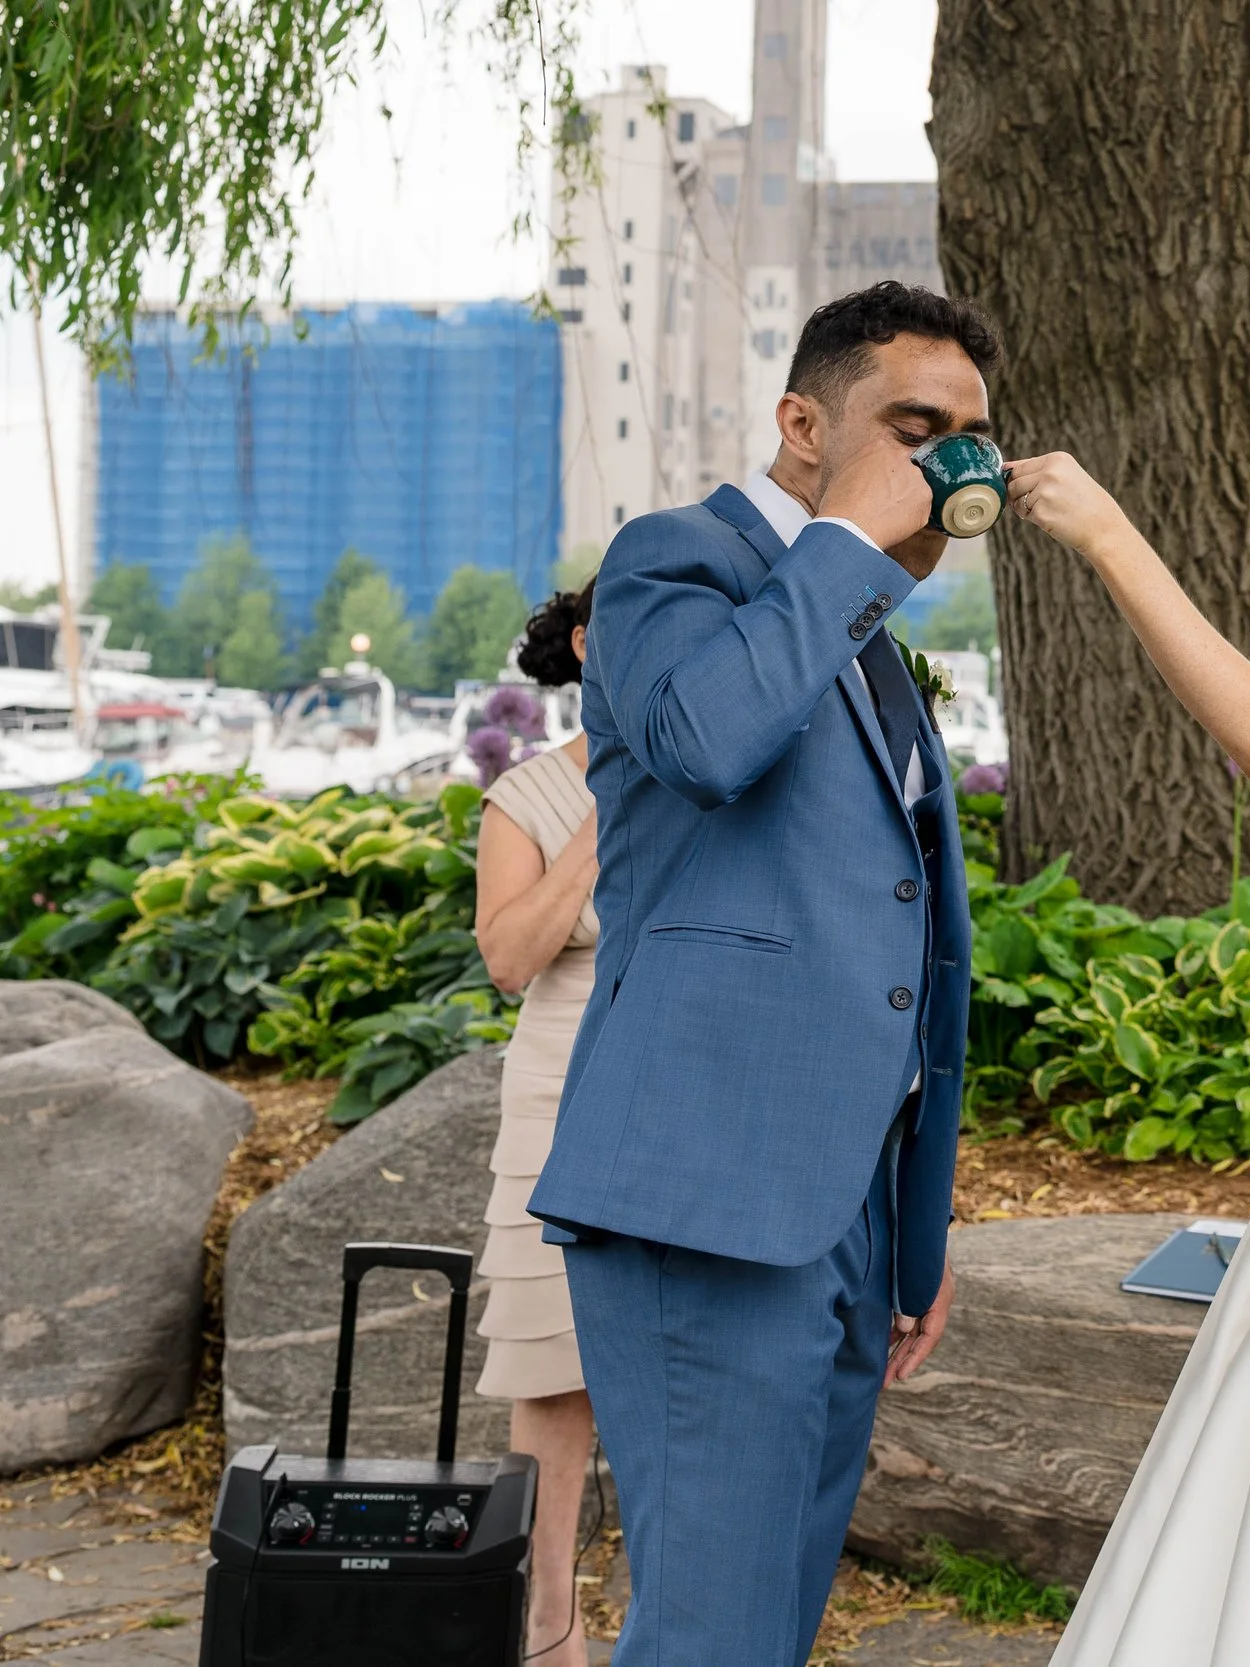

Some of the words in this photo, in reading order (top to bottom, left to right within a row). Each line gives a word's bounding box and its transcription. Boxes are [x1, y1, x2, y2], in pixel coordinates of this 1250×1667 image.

[333, 1492, 361, 1500] BLOCK
[362, 1493, 396, 1501] ROCKER
[396, 1494, 417, 1502] PLUS
[341, 1558, 390, 1570] ION
